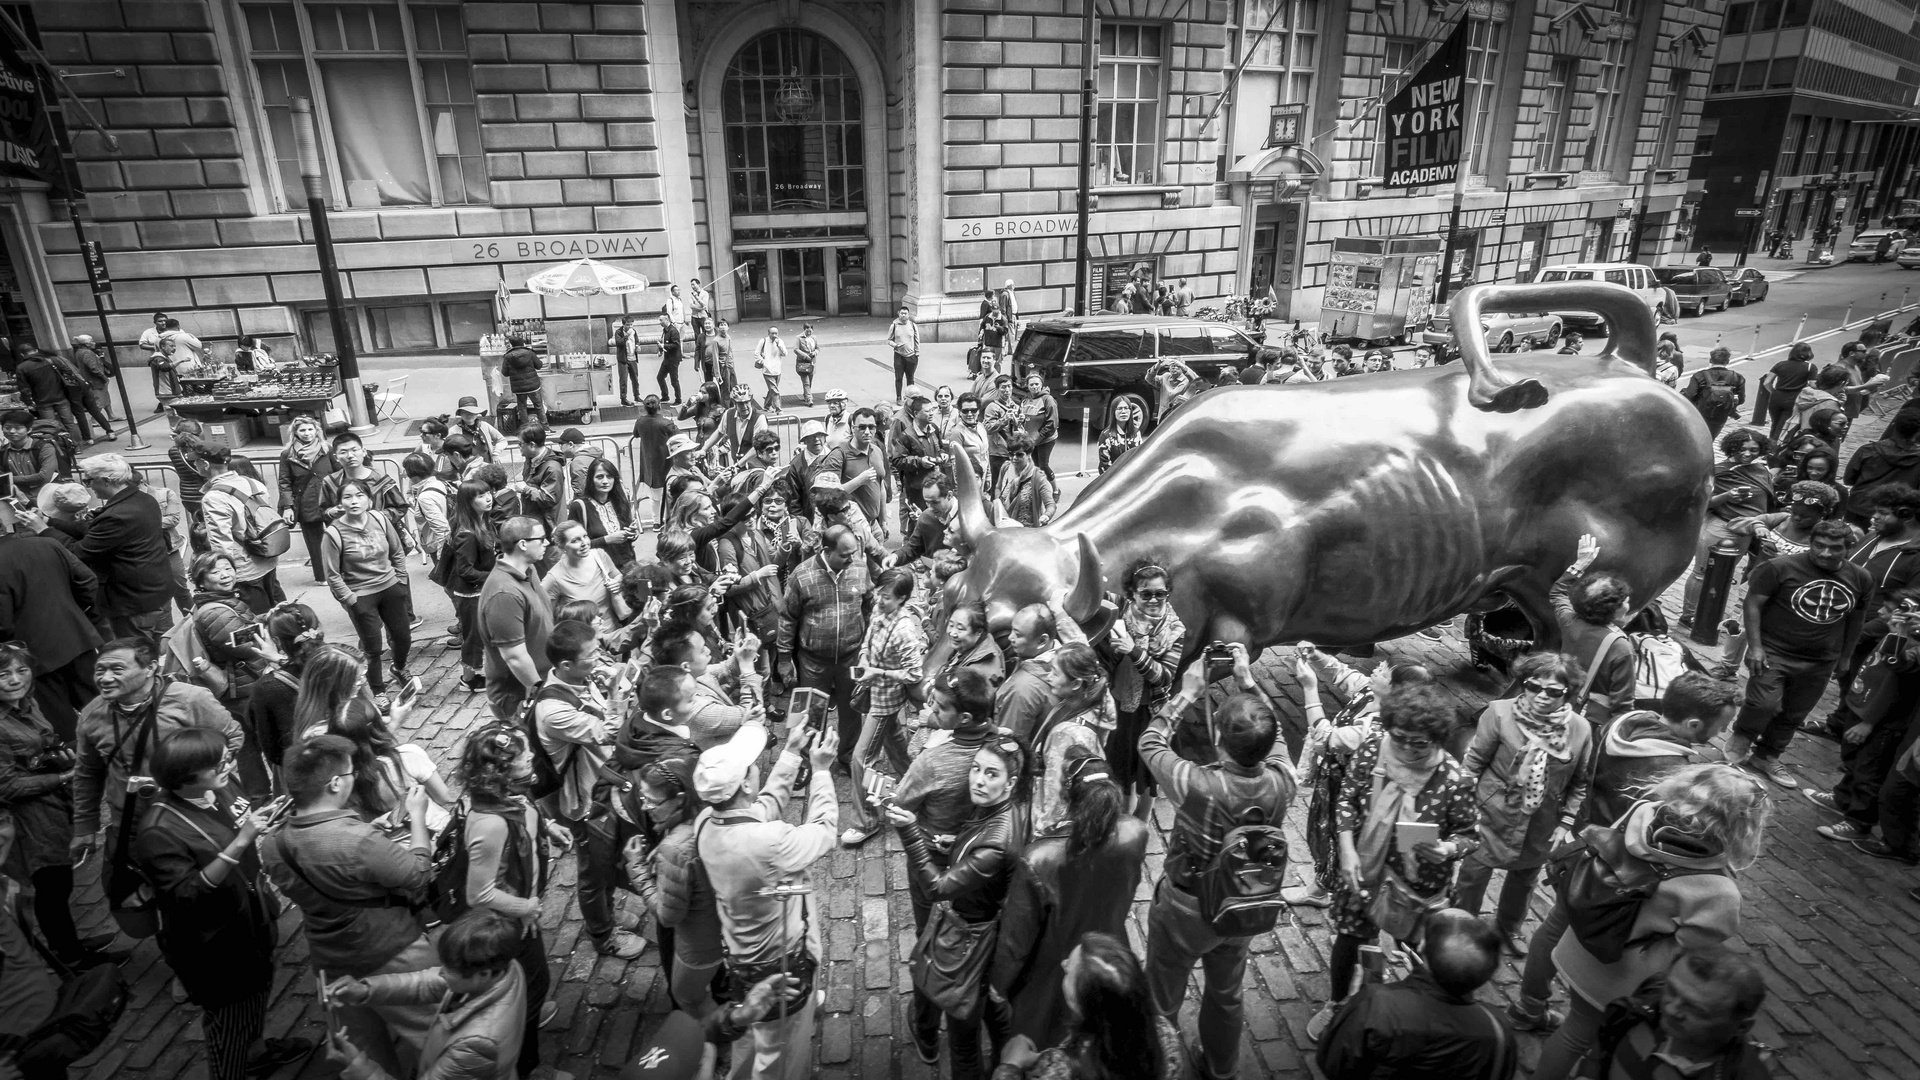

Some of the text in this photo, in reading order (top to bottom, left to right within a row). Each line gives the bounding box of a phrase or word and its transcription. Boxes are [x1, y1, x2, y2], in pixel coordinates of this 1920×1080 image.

[1411, 75, 1461, 109] NEW
[1391, 103, 1460, 136] YORK
[1391, 129, 1460, 168] FILM
[1389, 164, 1458, 186] ACADEMY
[961, 222, 982, 237] 26
[473, 236, 648, 259] 26 BROADWAY
